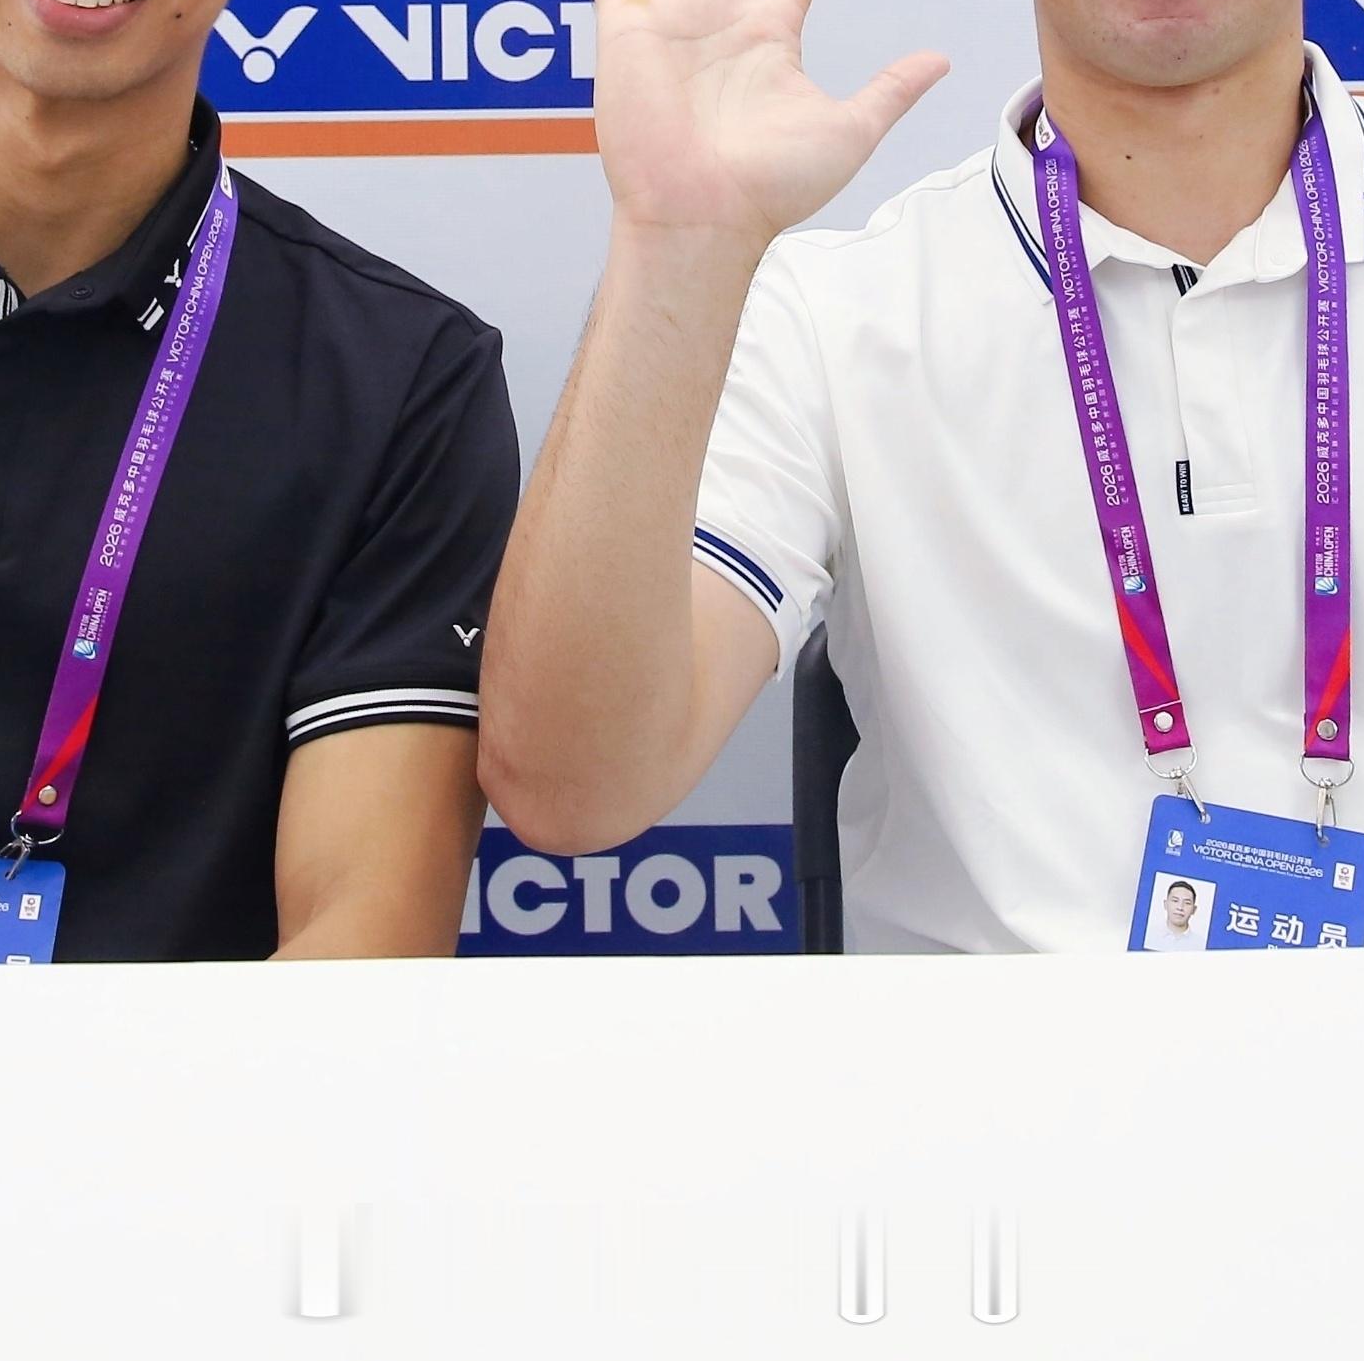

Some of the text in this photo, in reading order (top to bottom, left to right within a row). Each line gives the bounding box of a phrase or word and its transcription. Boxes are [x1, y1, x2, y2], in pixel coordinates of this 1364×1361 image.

[1047, 175, 1060, 208] OPEN
[1301, 167, 1319, 200] OPEN
[1049, 208, 1065, 250] CHINA
[1309, 202, 1325, 240] CHINA
[1057, 250, 1076, 303] VICTOR
[1315, 242, 1329, 294] VICTOR
[166, 313, 193, 362] VICTOR
[185, 276, 205, 314] CHINA
[197, 240, 215, 275] OPEN
[1179, 463, 1190, 512] READY TO WIN
[1120, 526, 1134, 550] OPEN
[1323, 526, 1334, 576] CHINA OPEN
[1118, 554, 1129, 577] VICTOR
[1125, 549, 1139, 576] CHINA
[1315, 553, 1323, 576] VICTOR
[93, 589, 108, 614] OPEN
[77, 614, 90, 637] VICTOR
[86, 614, 101, 641] CHINA
[1193, 844, 1232, 860] VICTOR
[1232, 852, 1265, 867] CHINA
[1265, 858, 1295, 873] OPEN
[1295, 865, 1324, 878] 2026
[1226, 903, 1348, 949] 运动员
